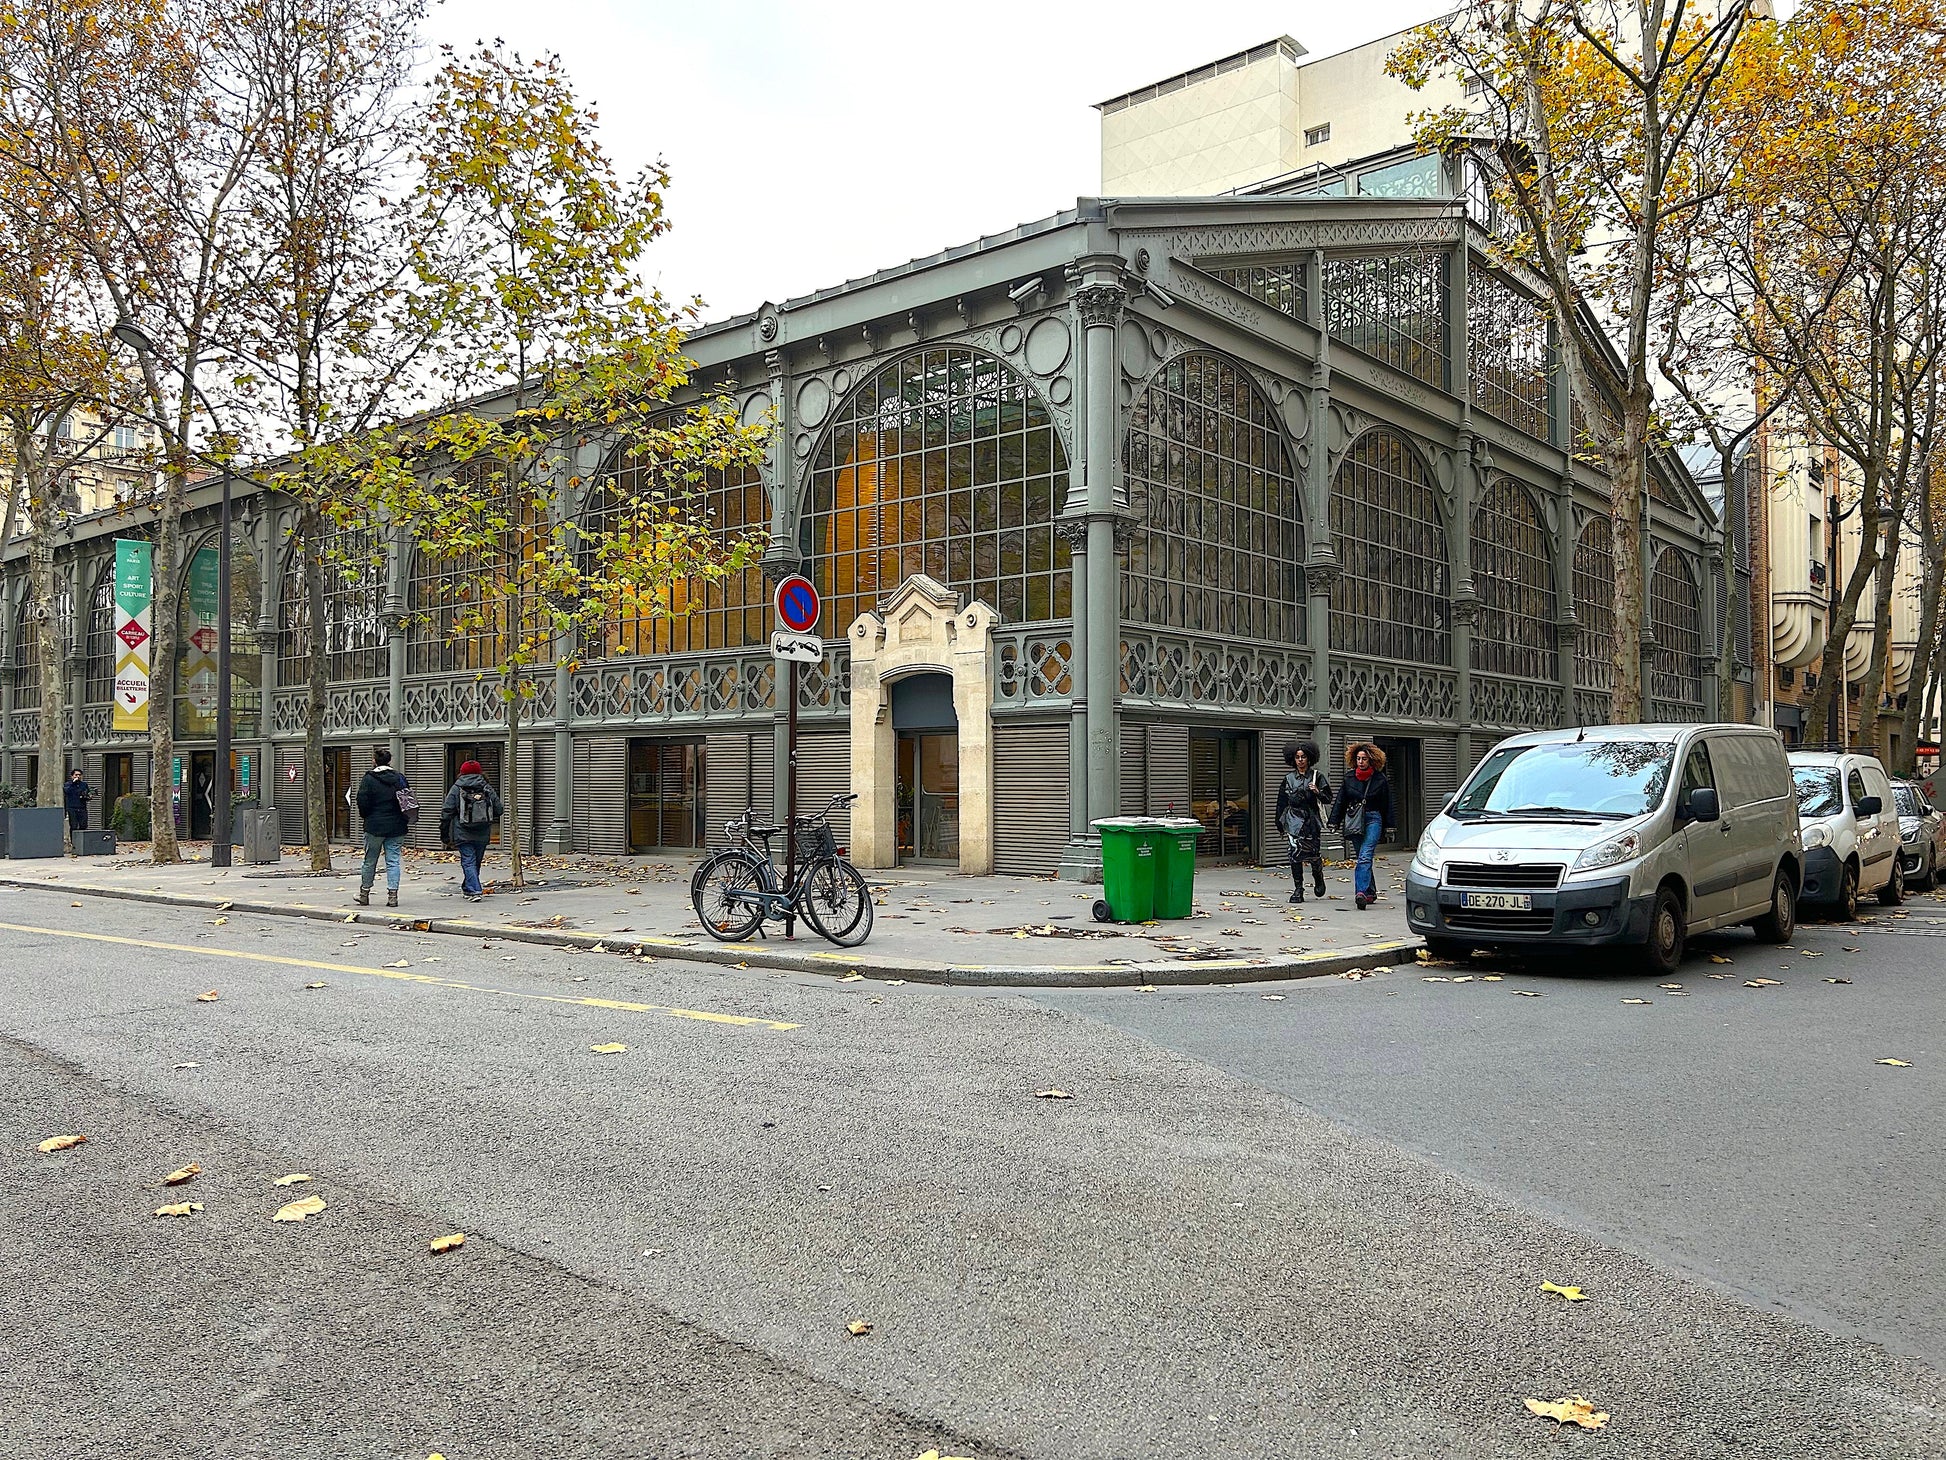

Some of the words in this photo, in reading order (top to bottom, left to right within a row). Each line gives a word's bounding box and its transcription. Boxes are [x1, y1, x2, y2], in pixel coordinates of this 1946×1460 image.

[119, 591, 147, 599] CULTURE
[116, 679, 147, 687] ACCUEIL
[1468, 894, 1524, 909] DE-270-JL
